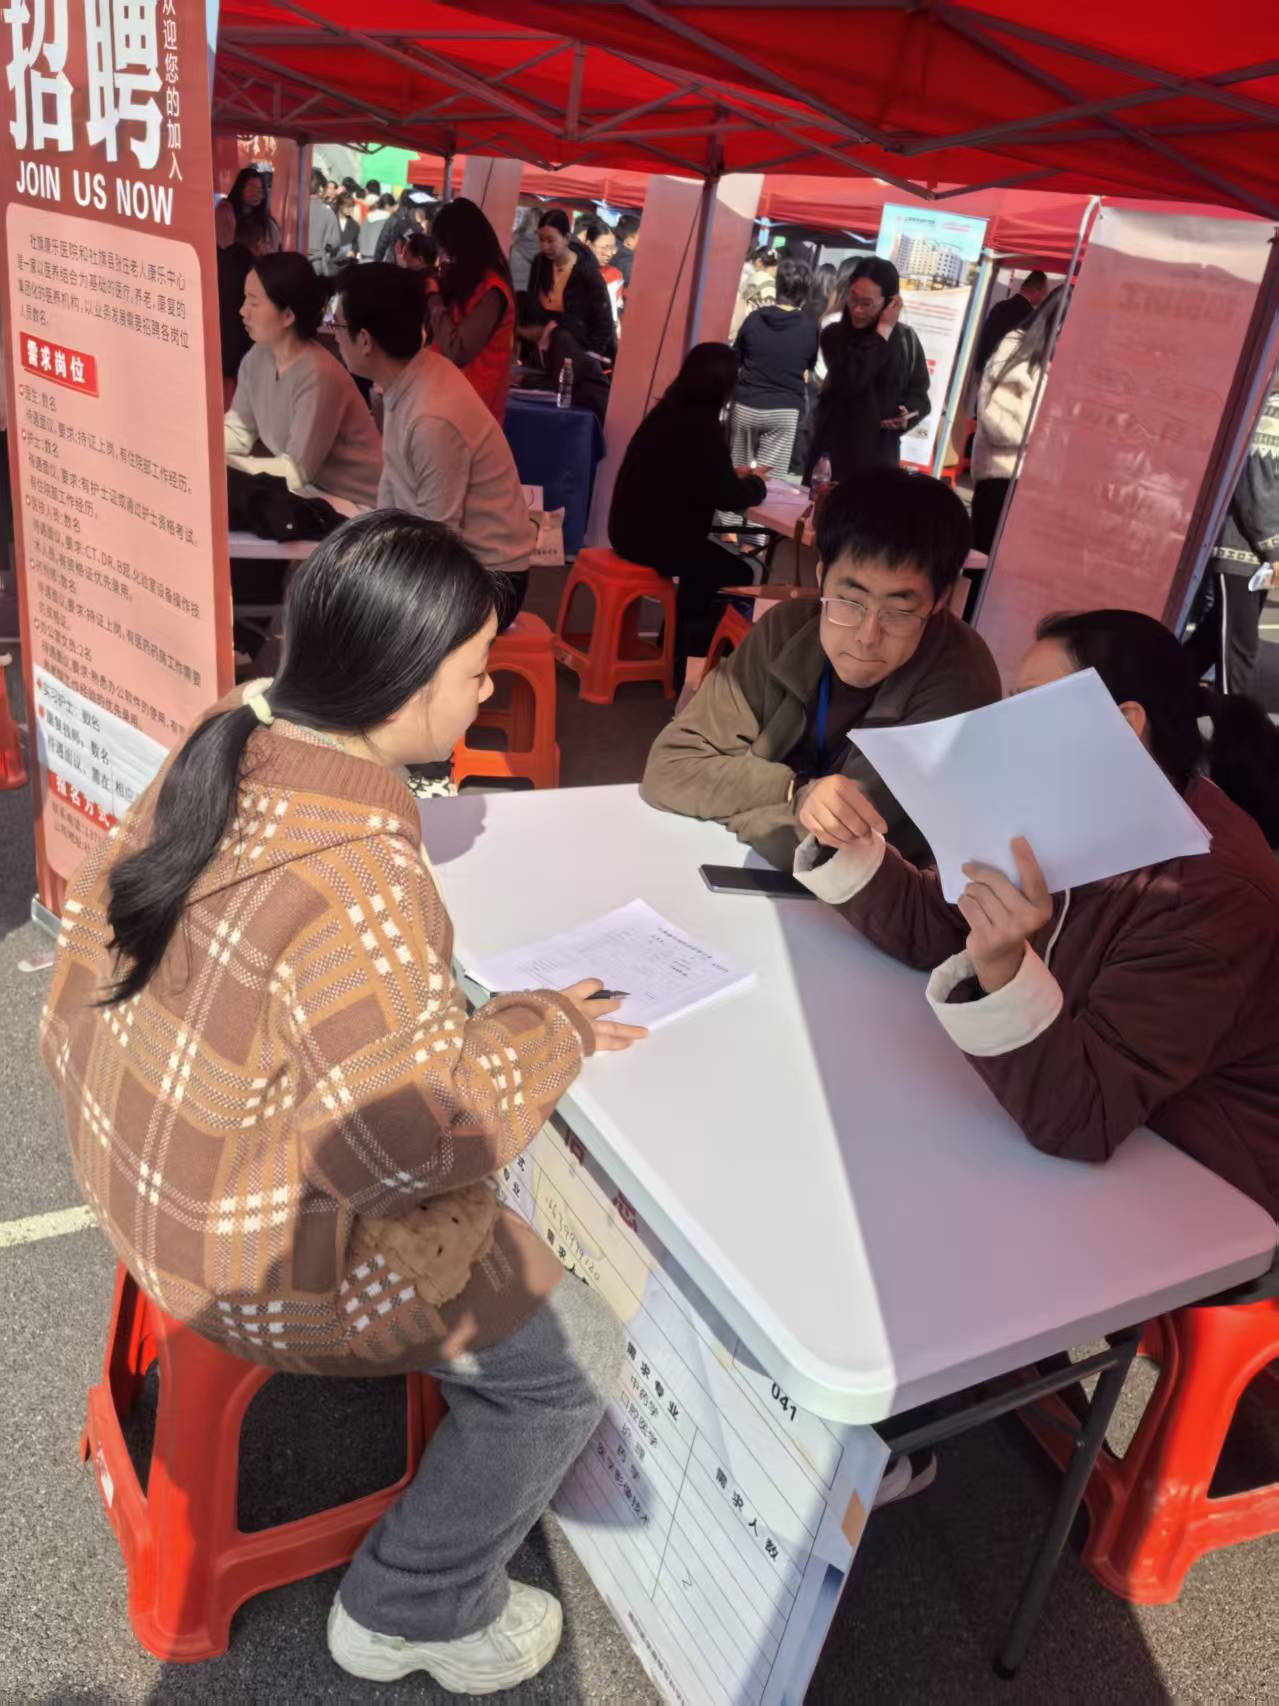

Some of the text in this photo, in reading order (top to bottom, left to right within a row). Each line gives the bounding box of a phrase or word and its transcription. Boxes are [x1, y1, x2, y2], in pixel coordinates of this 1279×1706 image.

[2, 0, 163, 169] 招聘
[16, 160, 173, 225] JOIN US NOW
[27, 340, 86, 384] 需求岗位
[547, 1228, 590, 1286] 需求人
[771, 1382, 798, 1421] 041
[715, 1467, 779, 1562] 需求人数
